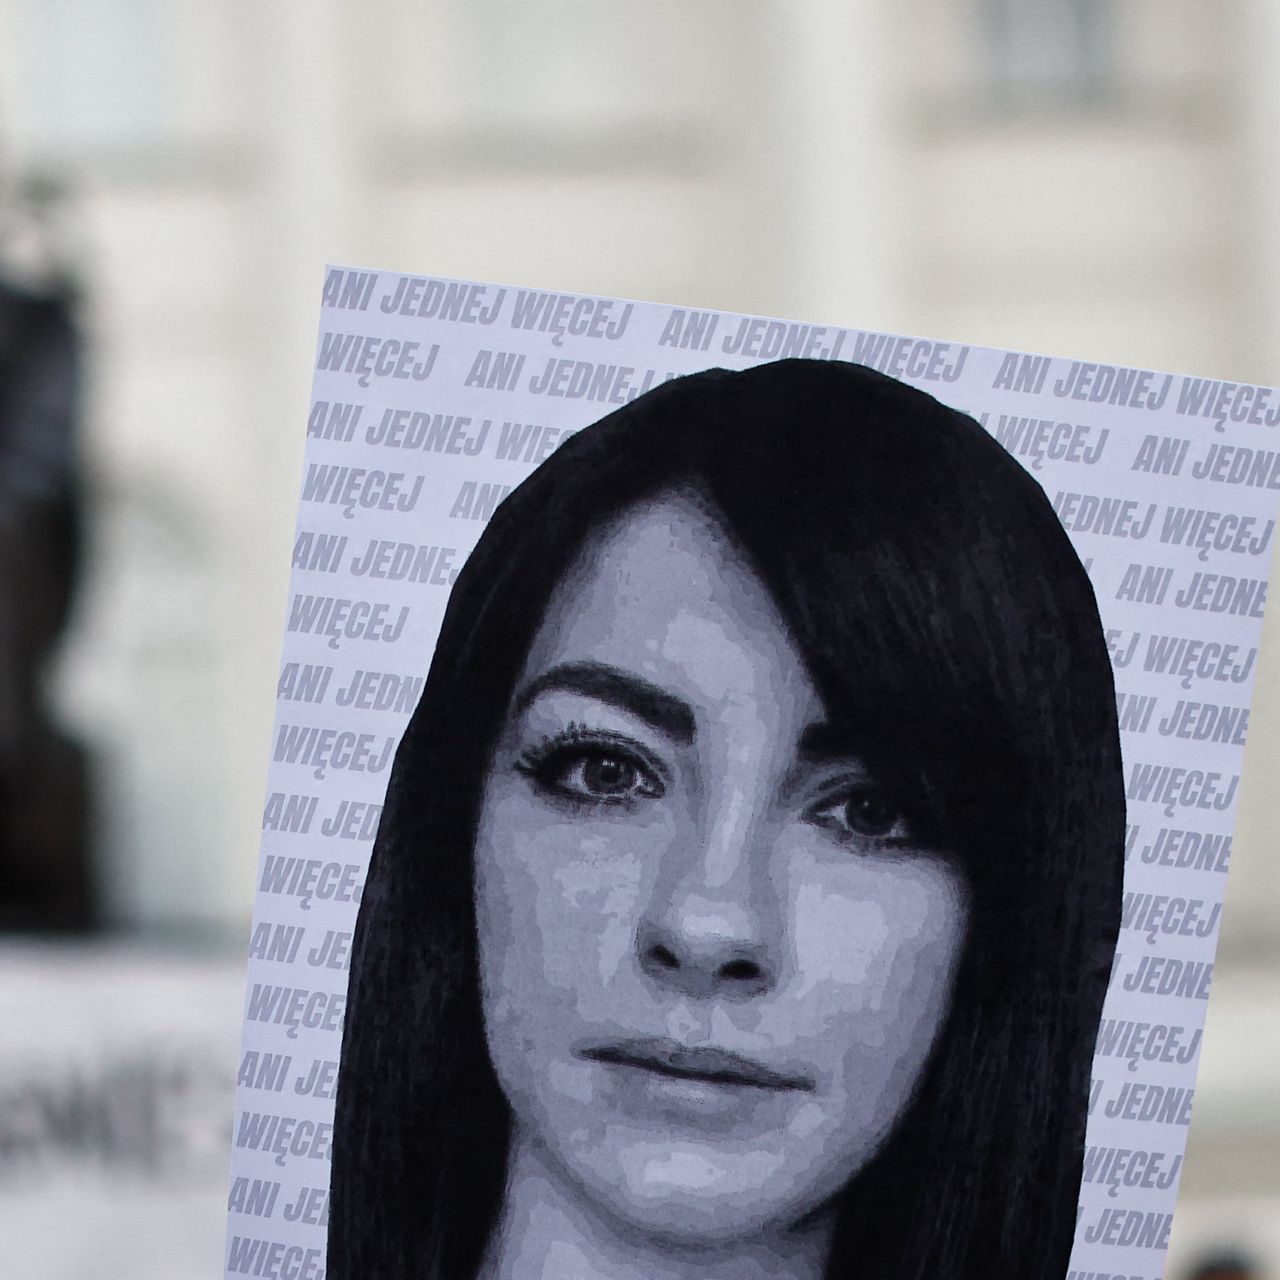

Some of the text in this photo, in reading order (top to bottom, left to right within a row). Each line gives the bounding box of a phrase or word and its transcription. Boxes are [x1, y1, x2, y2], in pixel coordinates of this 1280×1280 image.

[317, 332, 440, 388] WIĘCEJ
[464, 349, 526, 392] ANI
[322, 269, 378, 312] ANI
[380, 277, 507, 325] JEDNEJ
[511, 290, 634, 347] WIĘCEJ
[658, 309, 720, 351] ANI
[992, 352, 1052, 395] ANI
[1053, 361, 1174, 411] JEDNEJ
[307, 401, 364, 443] ANI
[365, 408, 492, 457] JEDNEJ
[994, 414, 1110, 471] WIĘCEJ
[1130, 434, 1191, 476] ANI
[301, 463, 426, 519] WIĘCEJ
[291, 531, 462, 586] ANI JEDNE
[1159, 506, 1276, 562] WIĘCEJ
[1115, 563, 1174, 605] ANI
[287, 593, 410, 650] WIĘCEJ
[276, 662, 334, 704] ANI
[1143, 634, 1258, 690] WIĘCEJ
[273, 724, 396, 780] WIĘCEJ
[262, 792, 320, 834] ANI
[1126, 763, 1241, 818] WIĘCEJ
[249, 922, 306, 964] ANI
[246, 984, 346, 1040] WIĘCE
[236, 1050, 292, 1093] ANI
[236, 1111, 332, 1167] WIĘCE
[227, 1177, 281, 1218] ANI
